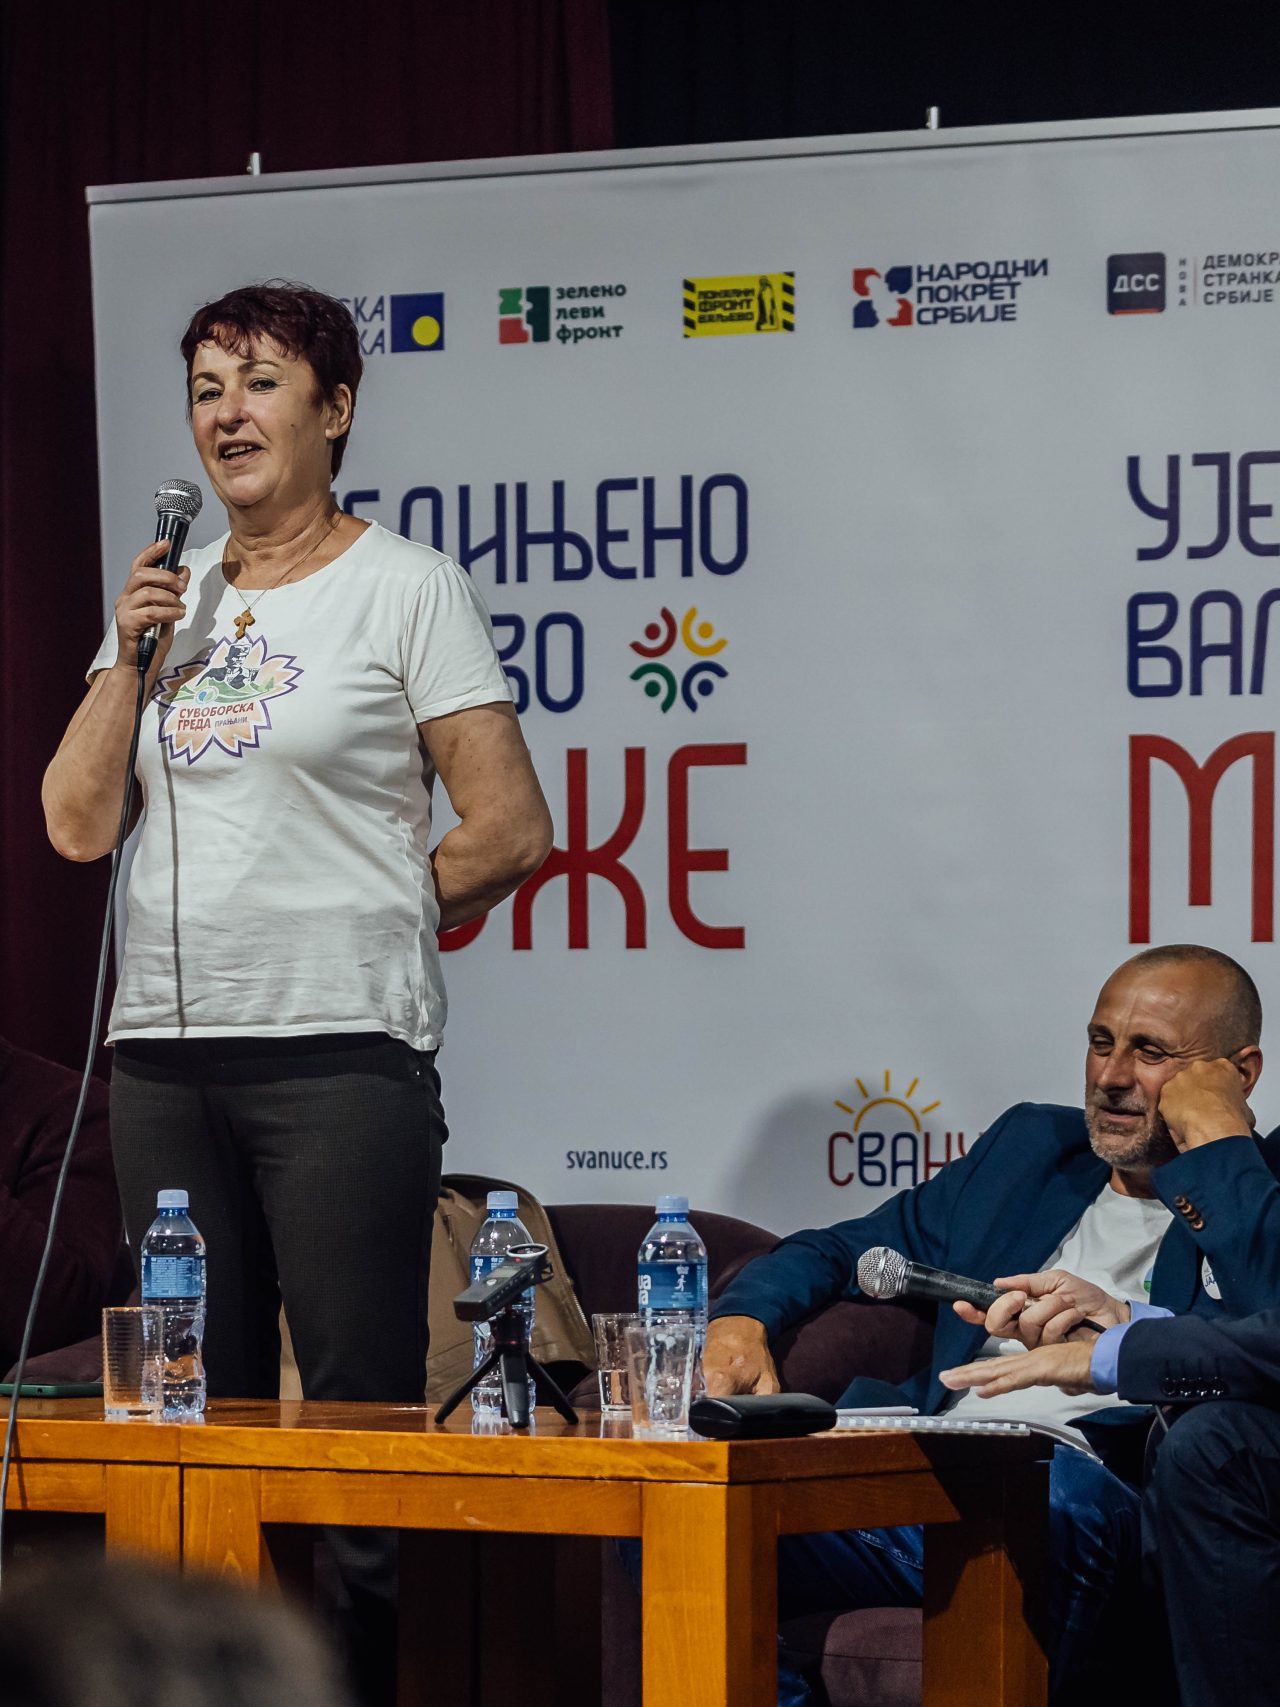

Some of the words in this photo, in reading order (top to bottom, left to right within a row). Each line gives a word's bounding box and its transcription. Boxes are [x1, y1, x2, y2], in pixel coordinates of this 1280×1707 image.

[916, 258, 1049, 283] НАРОДНИ
[1203, 252, 1280, 270] ДЕМОКР
[555, 283, 627, 300] зелено
[916, 281, 1022, 304] ПОКРЕТ
[1113, 273, 1160, 293] ДСС
[1203, 289, 1273, 305] СРБИЈЕ
[340, 296, 385, 322] КА
[555, 305, 605, 320] леви
[916, 303, 1017, 326] СРБИЈЕ
[555, 323, 624, 345] фронт
[179, 702, 254, 719] СУВОБОРСКА
[177, 718, 211, 732] ГРЕДА
[438, 742, 748, 952] ЖЕ
[566, 1150, 669, 1170] svanuce.rs
